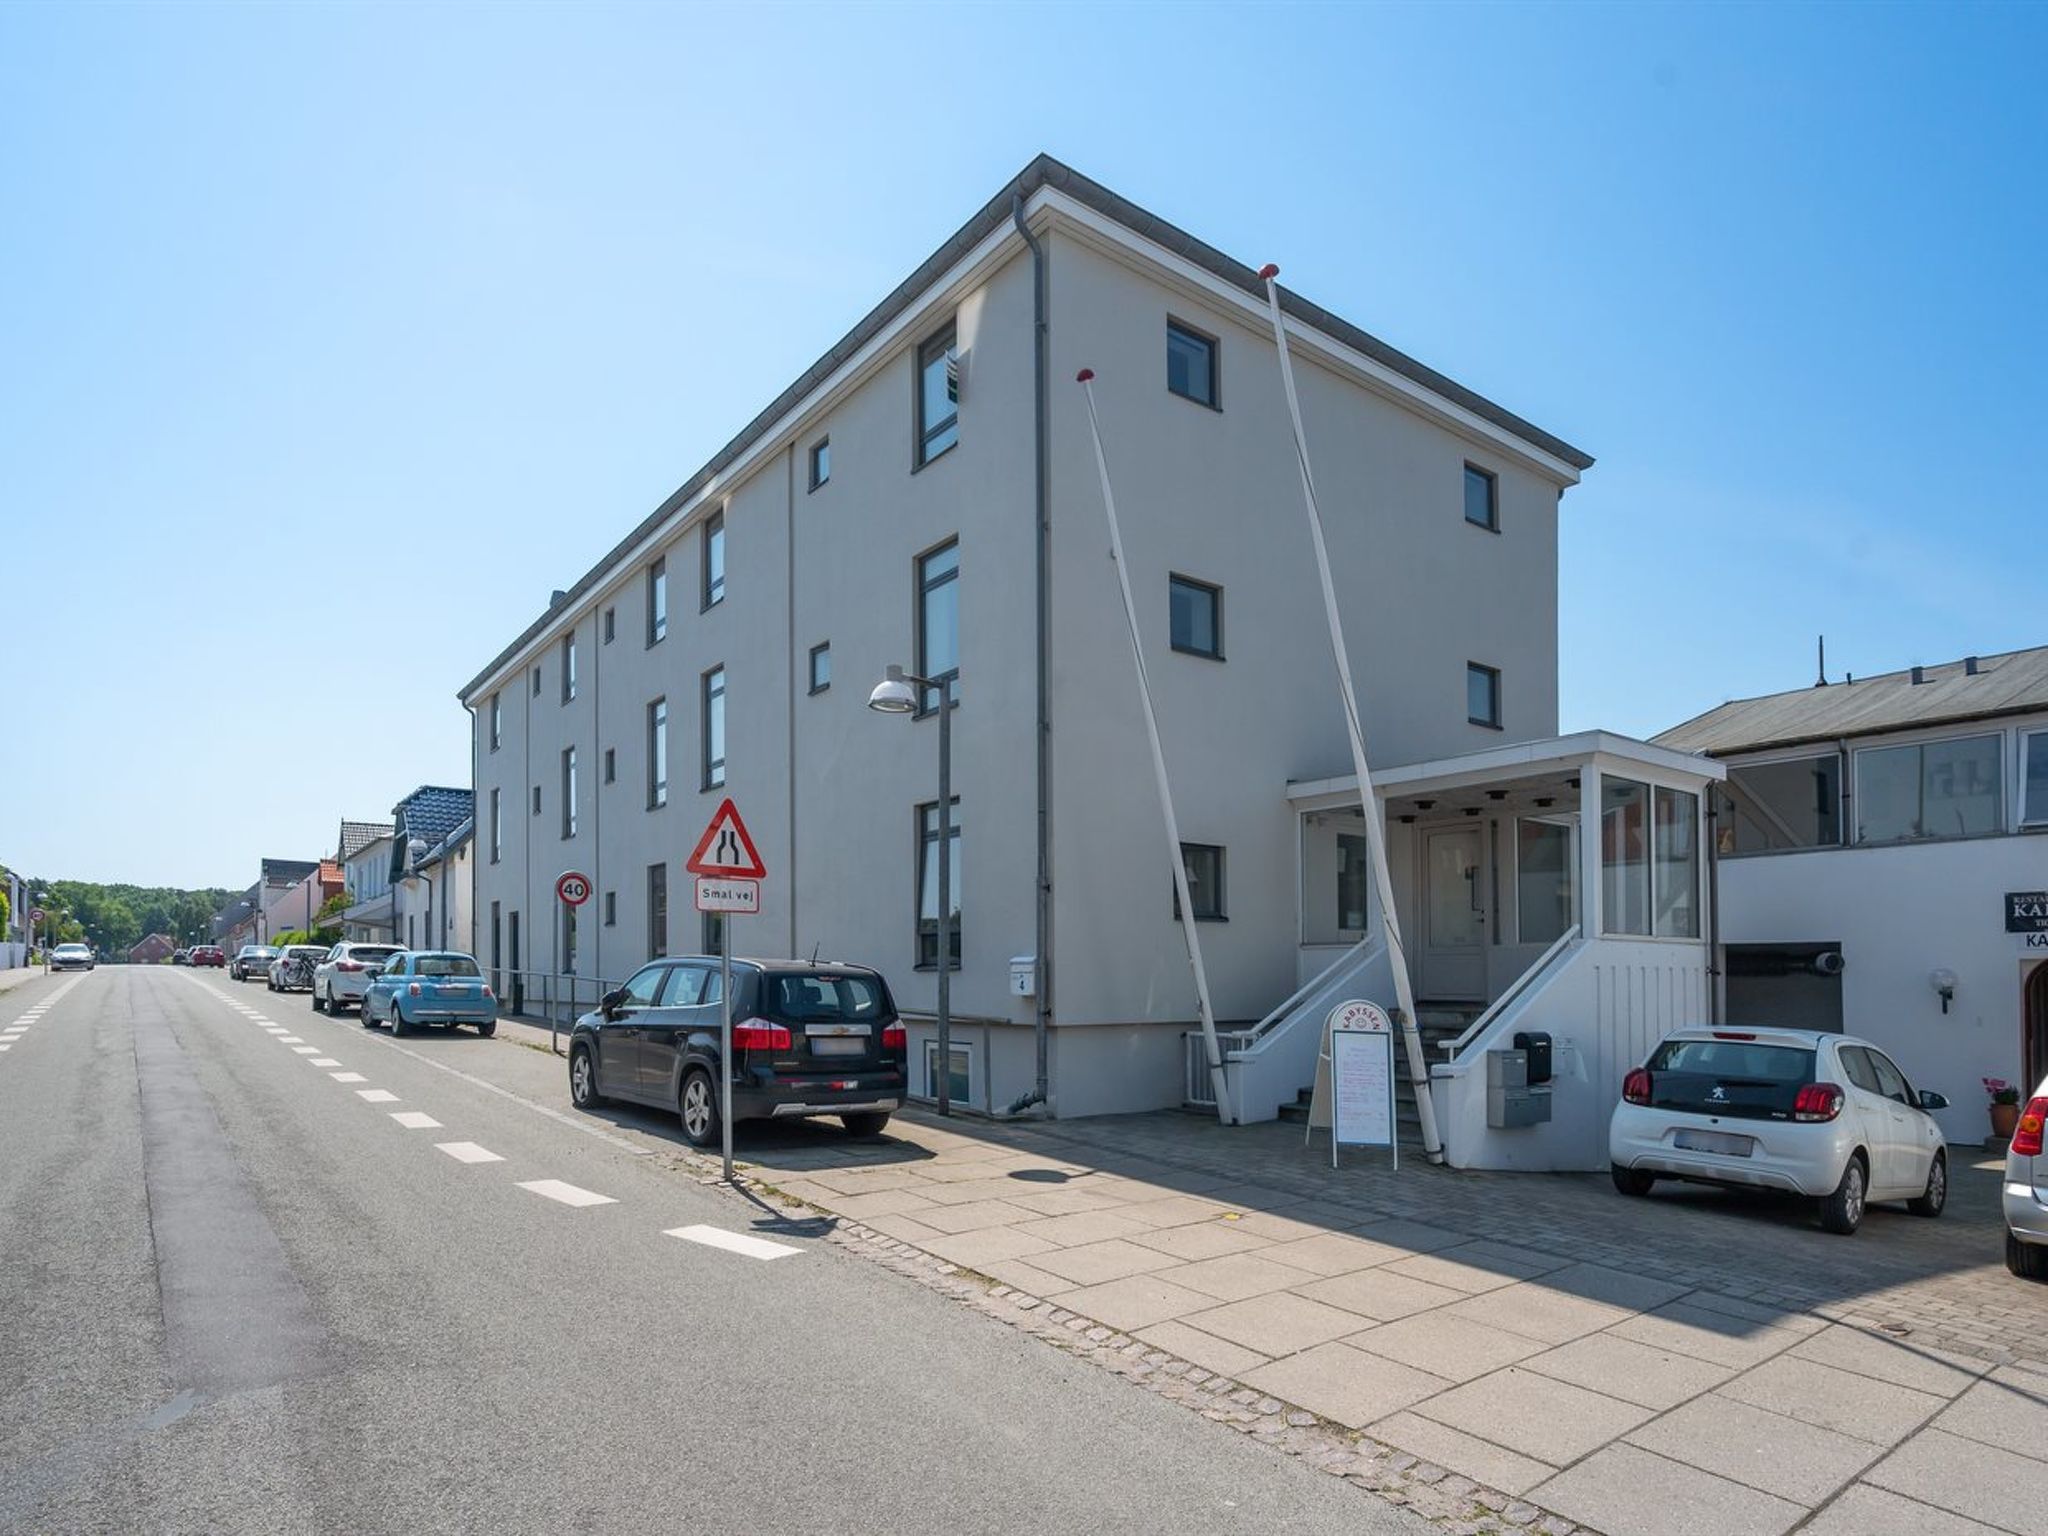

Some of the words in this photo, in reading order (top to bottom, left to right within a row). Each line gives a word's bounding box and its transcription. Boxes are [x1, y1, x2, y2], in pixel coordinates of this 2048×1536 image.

[564, 883, 584, 896] 40
[702, 888, 732, 899] Smal
[736, 890, 753, 902] vej
